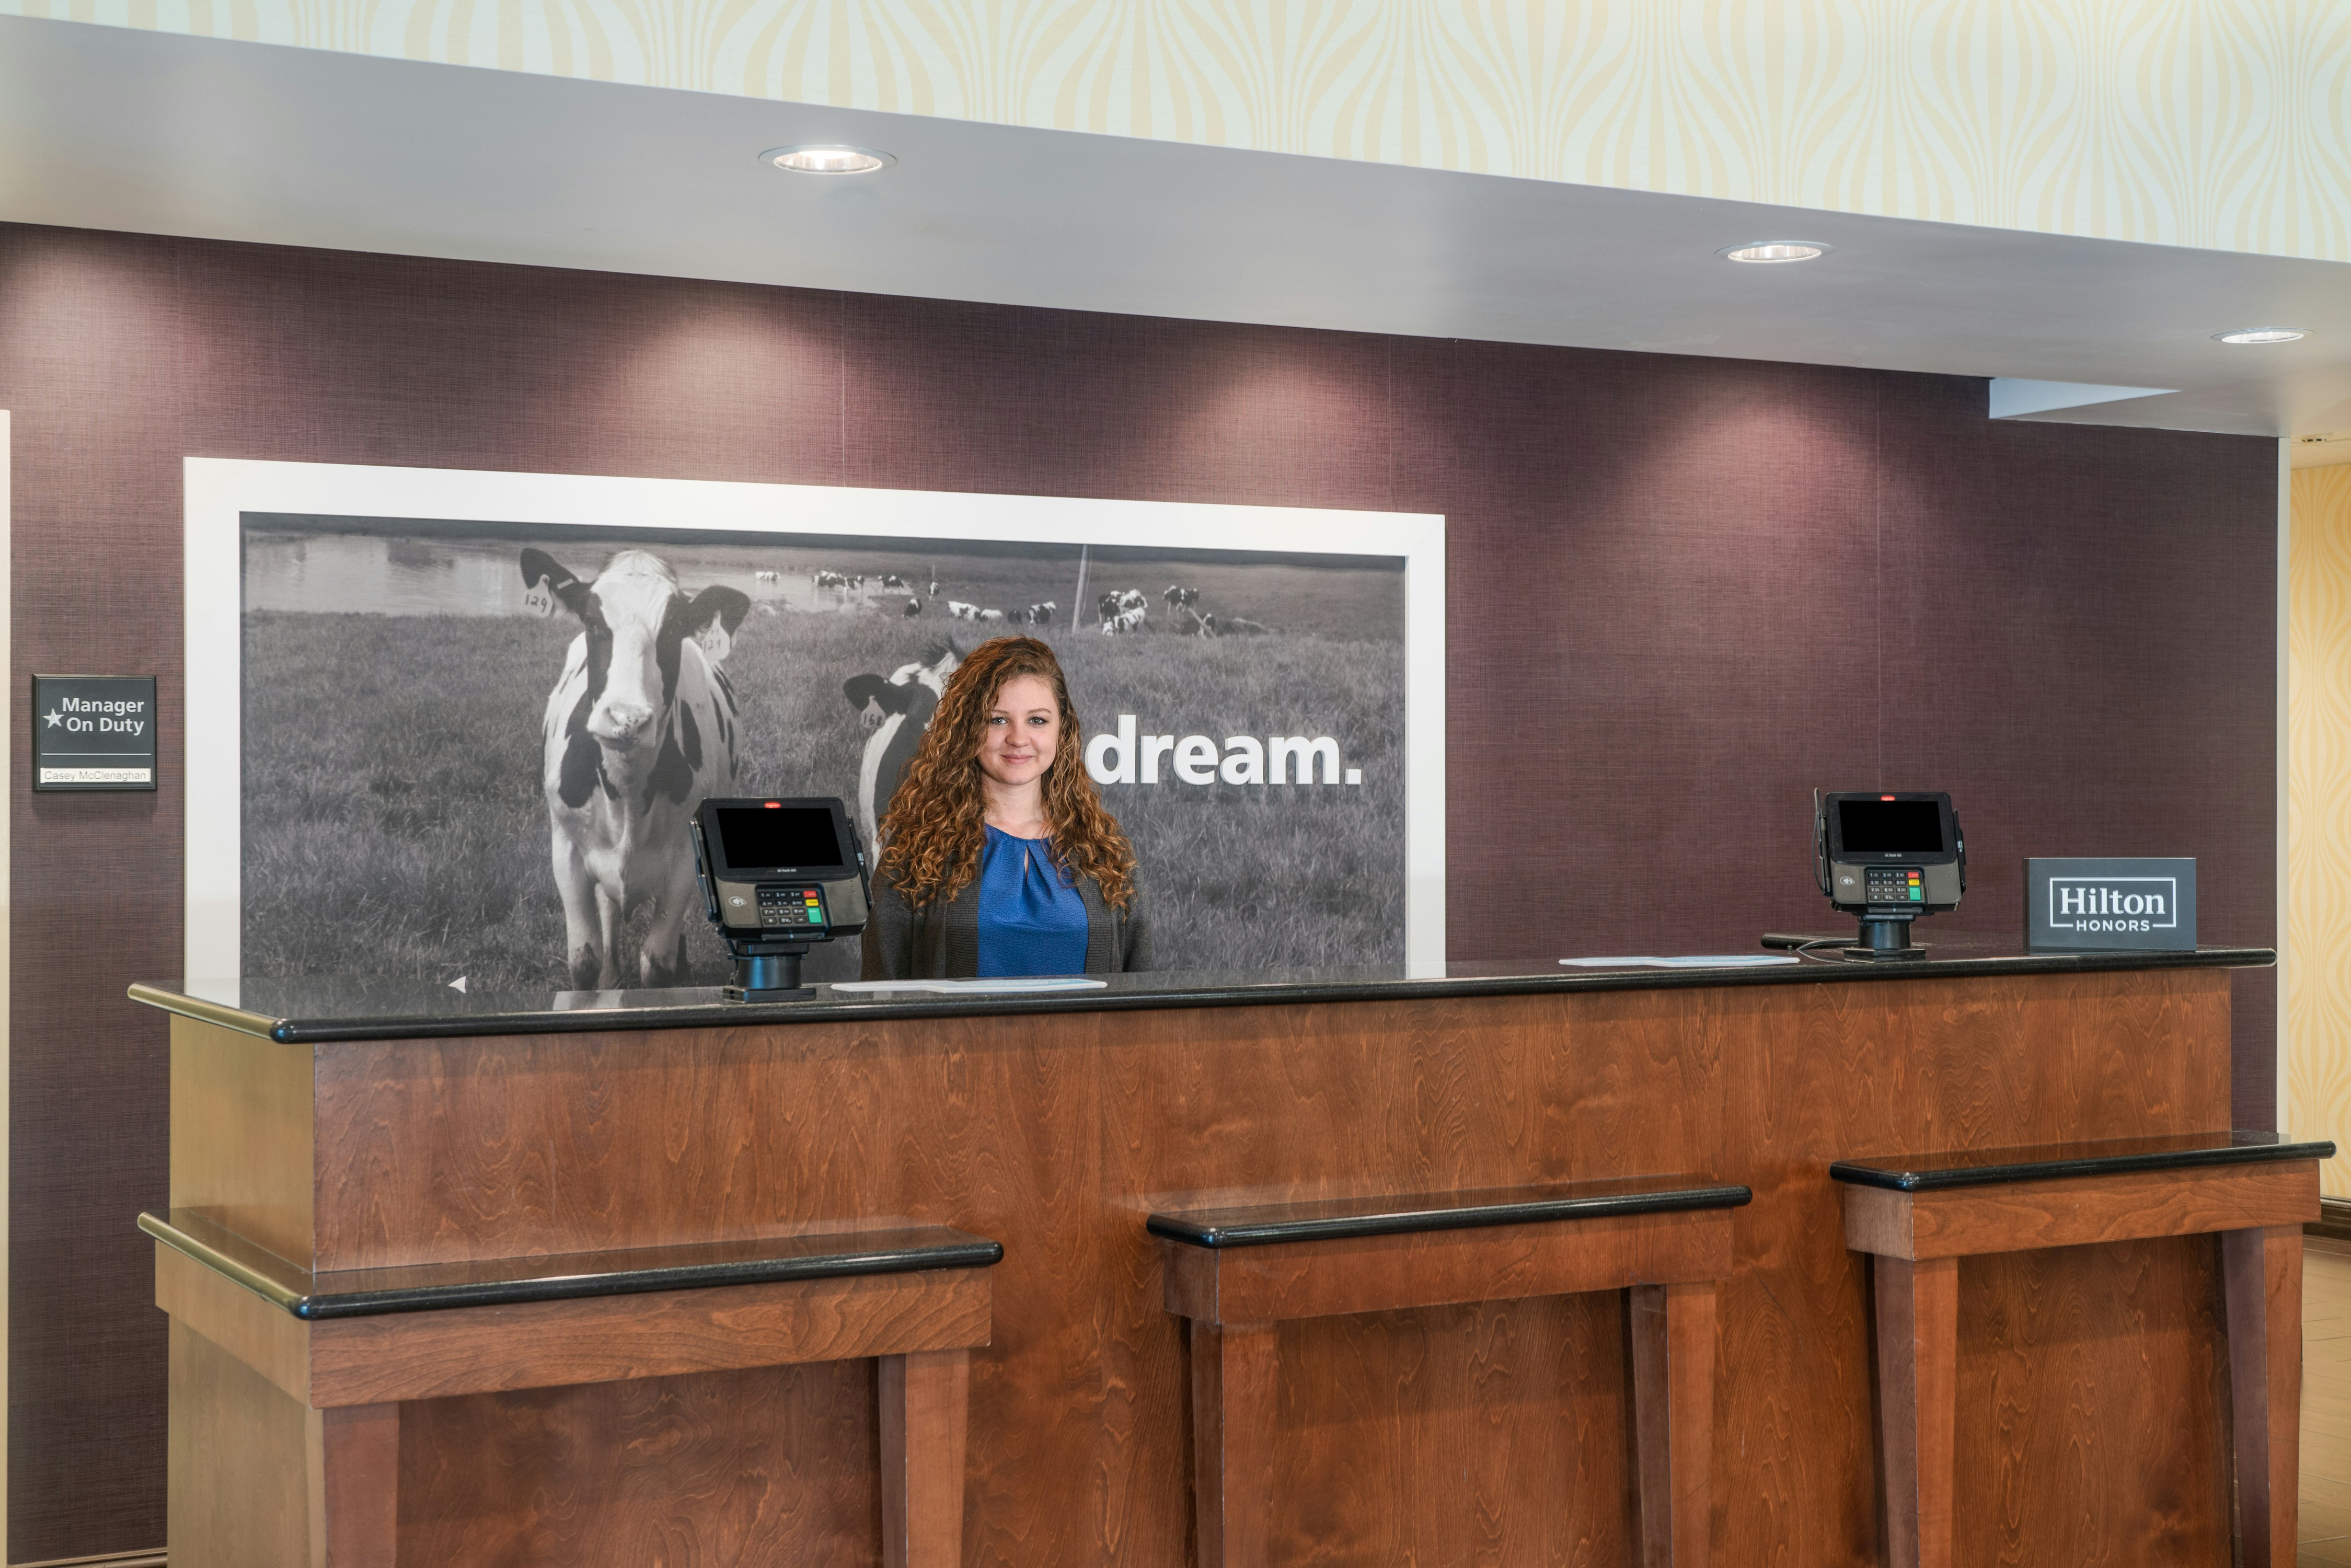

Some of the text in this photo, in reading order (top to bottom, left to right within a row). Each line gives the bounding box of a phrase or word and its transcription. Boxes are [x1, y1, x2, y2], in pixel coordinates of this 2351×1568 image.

[525, 594, 547, 613] 129
[704, 639, 721, 654] 129
[62, 697, 145, 716] Manager
[66, 717, 145, 736] On Duty
[1085, 714, 1362, 785] dream.
[45, 771, 146, 781] Casey McClenaghan
[2060, 887, 2165, 914] Hilton
[2076, 919, 2150, 931] HONORS
